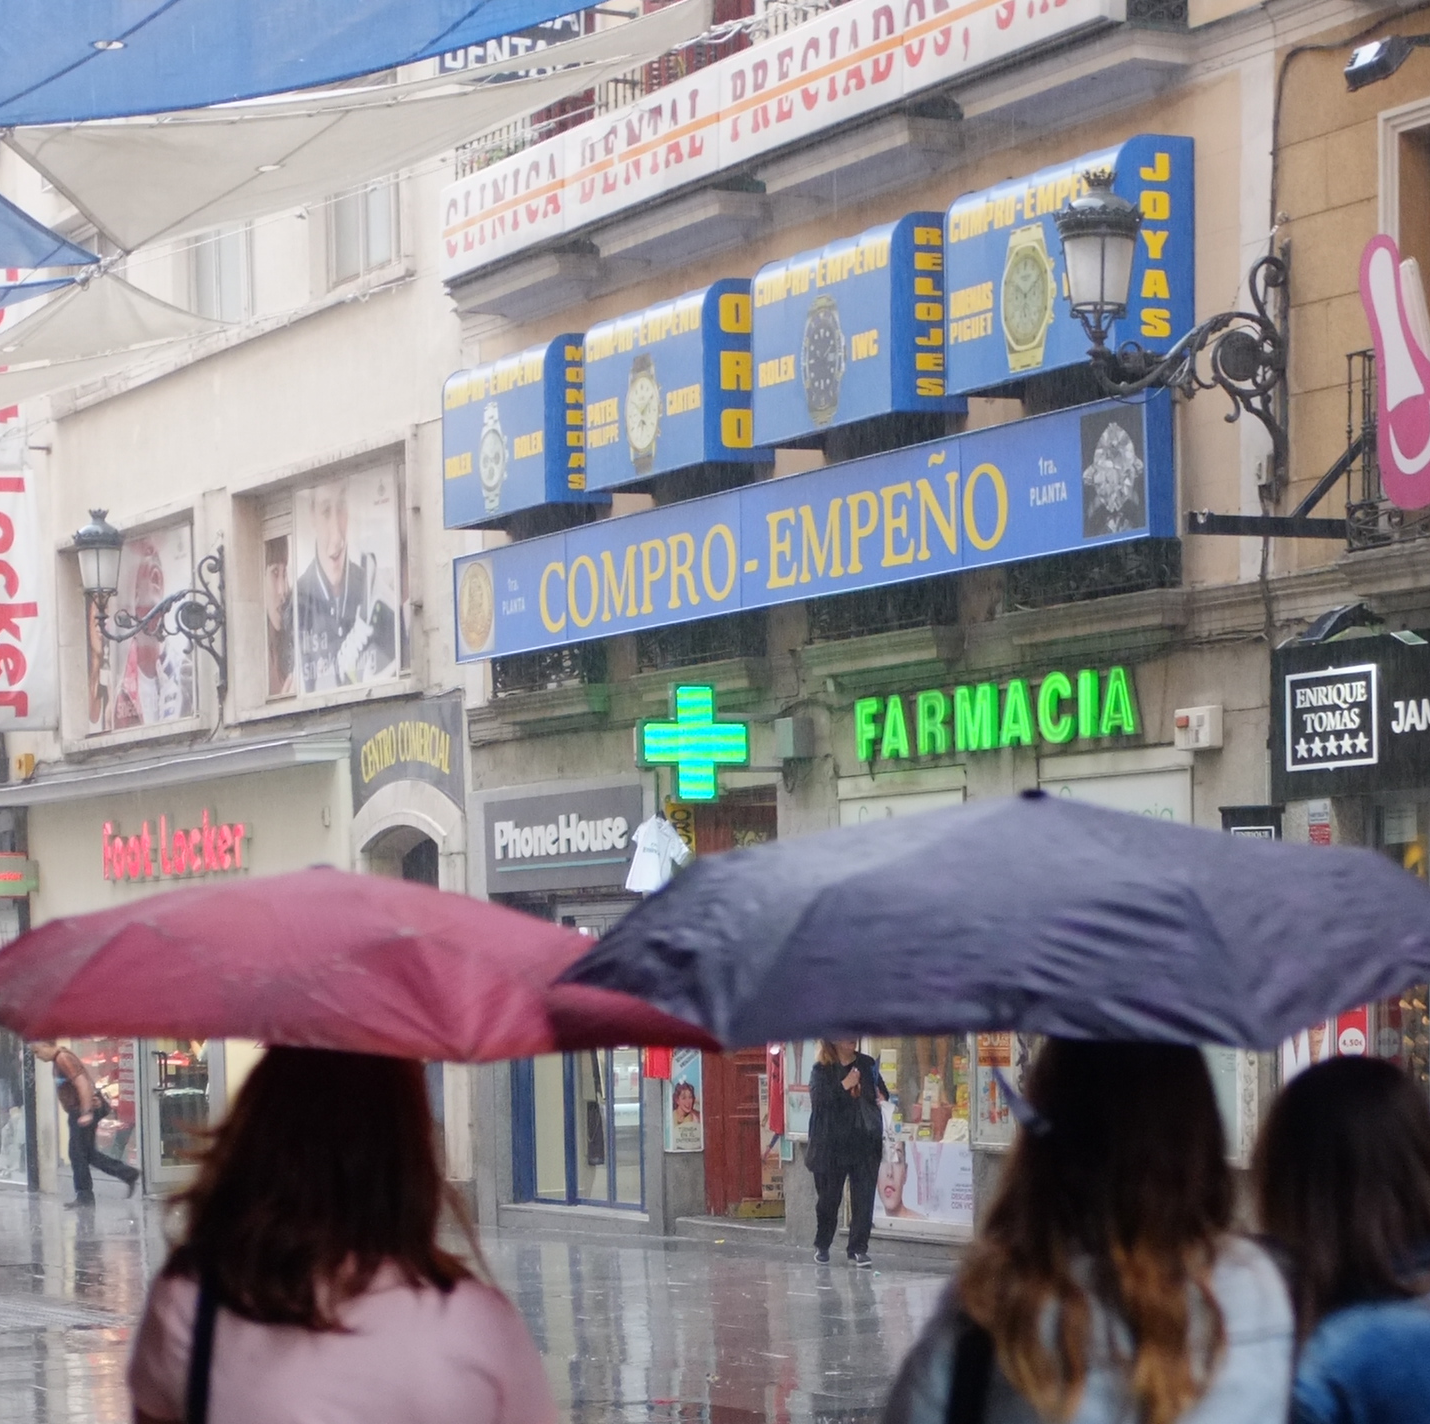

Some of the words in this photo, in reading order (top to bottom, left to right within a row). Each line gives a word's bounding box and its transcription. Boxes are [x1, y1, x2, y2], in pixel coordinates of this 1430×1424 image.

[444, 35, 565, 79] DENTA
[445, 152, 561, 259] CLINICA
[579, 89, 704, 205] DENTAL
[1139, 152, 1171, 338] JOYAS
[913, 226, 945, 397] RELOJES
[950, 312, 993, 345] PIGUET
[719, 292, 754, 449] ORO
[758, 354, 796, 388] ROLEX
[851, 328, 879, 361] IWC
[564, 345, 586, 490] MONEDAS
[587, 396, 619, 428] PATEK
[514, 430, 543, 460] ROLEX
[1030, 482, 1068, 508] PLANTA
[538, 452, 1008, 634] COMPRO-EMPEÑO
[854, 665, 1136, 762] FARMACIA
[1295, 679, 1368, 710] ENRIQUE
[360, 725, 397, 784] CENTRO
[398, 720, 451, 775] COMERCIAL
[103, 819, 154, 881] Foot
[160, 806, 247, 876] Locker
